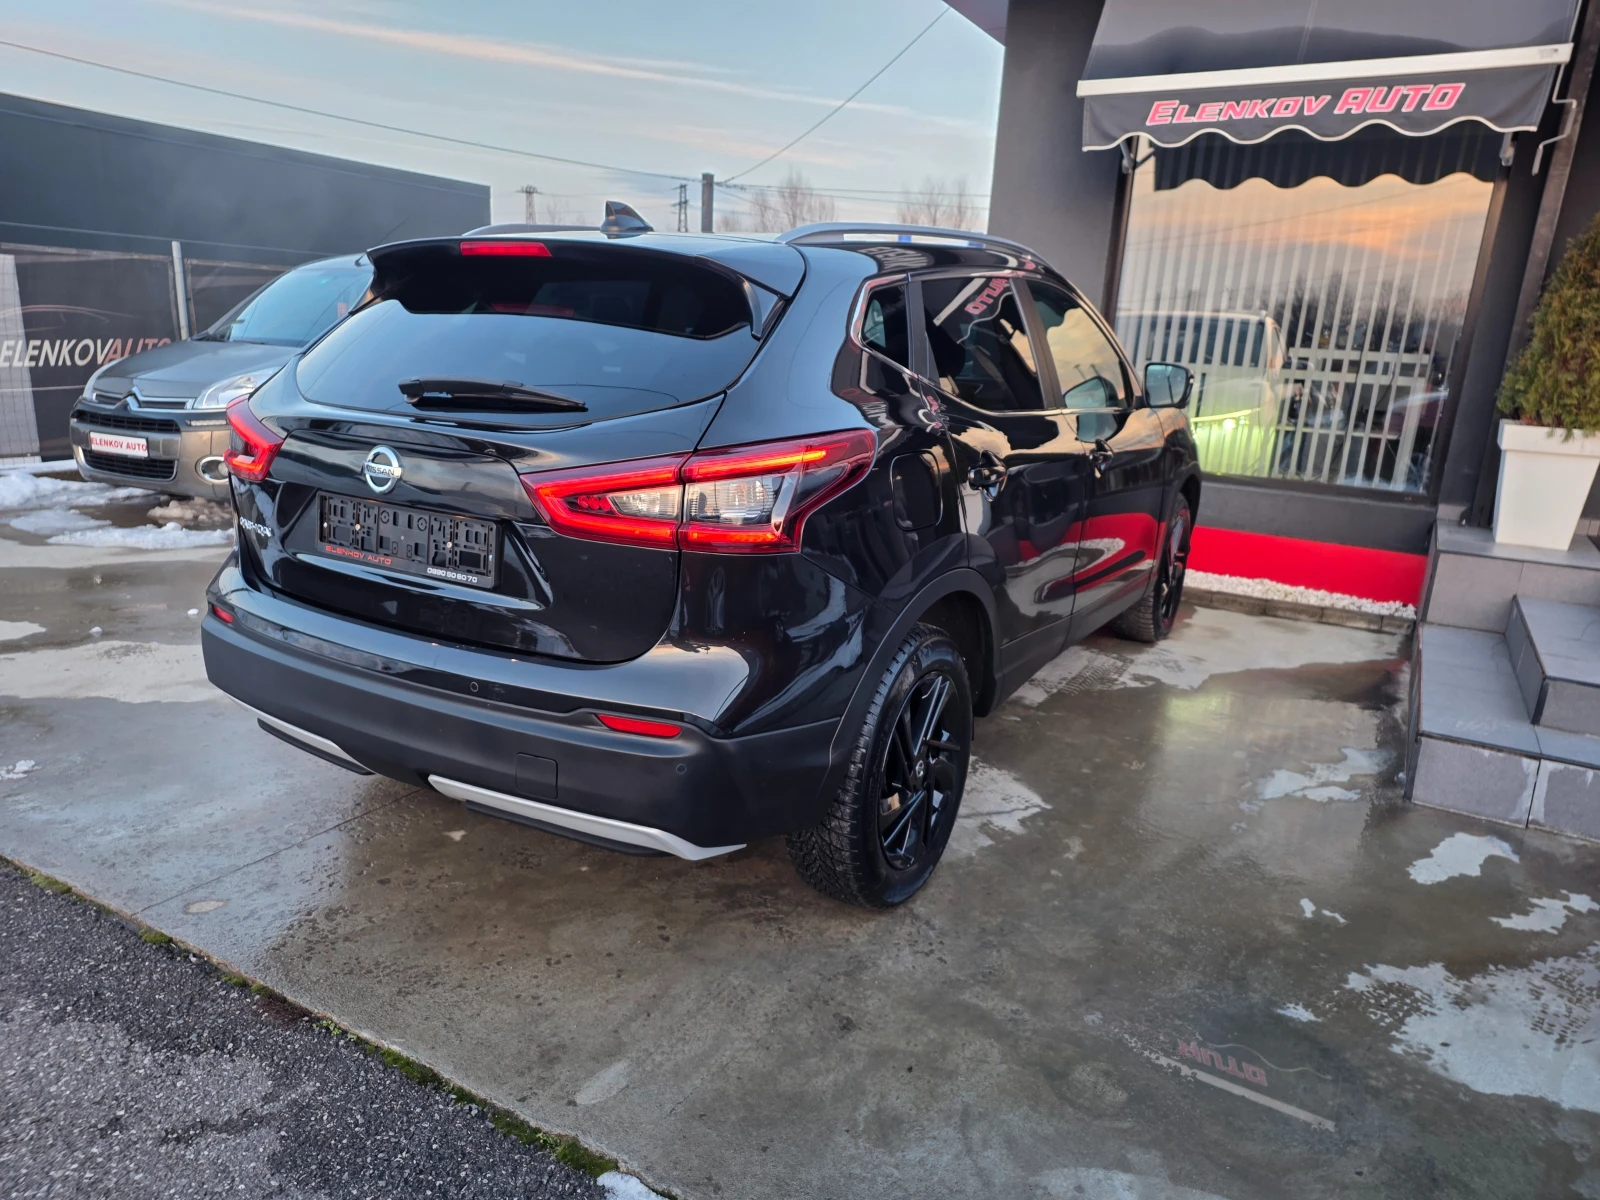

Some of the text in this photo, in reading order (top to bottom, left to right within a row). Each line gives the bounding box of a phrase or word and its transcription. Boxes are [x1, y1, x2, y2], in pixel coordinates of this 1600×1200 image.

[1146, 83, 1466, 126] ELENKOV AUTO
[90, 437, 148, 452] ELENKOV AUTO
[365, 464, 395, 476] NISSAN
[367, 555, 392, 565] AUTO
